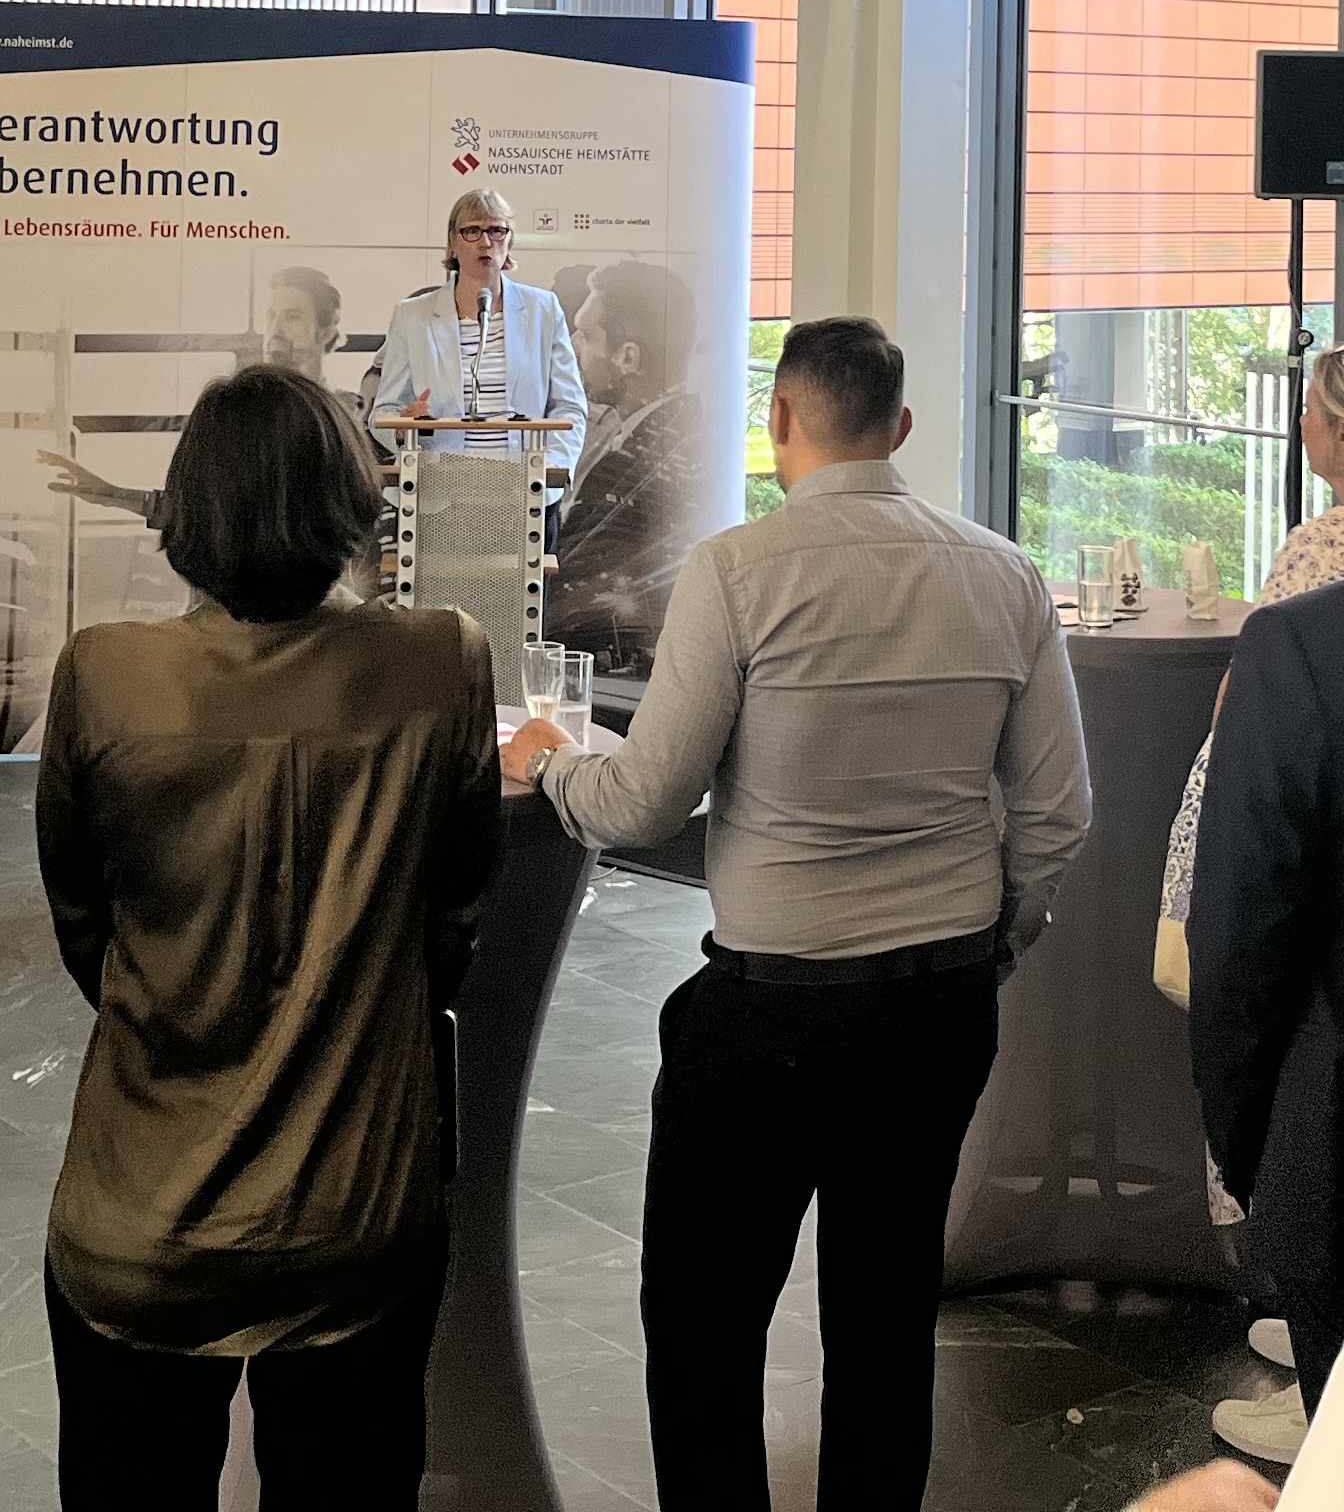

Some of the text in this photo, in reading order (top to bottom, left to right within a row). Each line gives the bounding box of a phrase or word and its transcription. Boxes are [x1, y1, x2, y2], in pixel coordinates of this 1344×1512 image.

[488, 129, 599, 141] UNTERNEHMENSGRUPPE
[488, 146, 651, 162] NASSAUISCHE HEIMSTÄTTE
[488, 163, 564, 176] WOHNSTADT
[5, 217, 143, 238] Lebensräume.
[151, 220, 180, 238] Für
[187, 220, 291, 240] Menschen.
